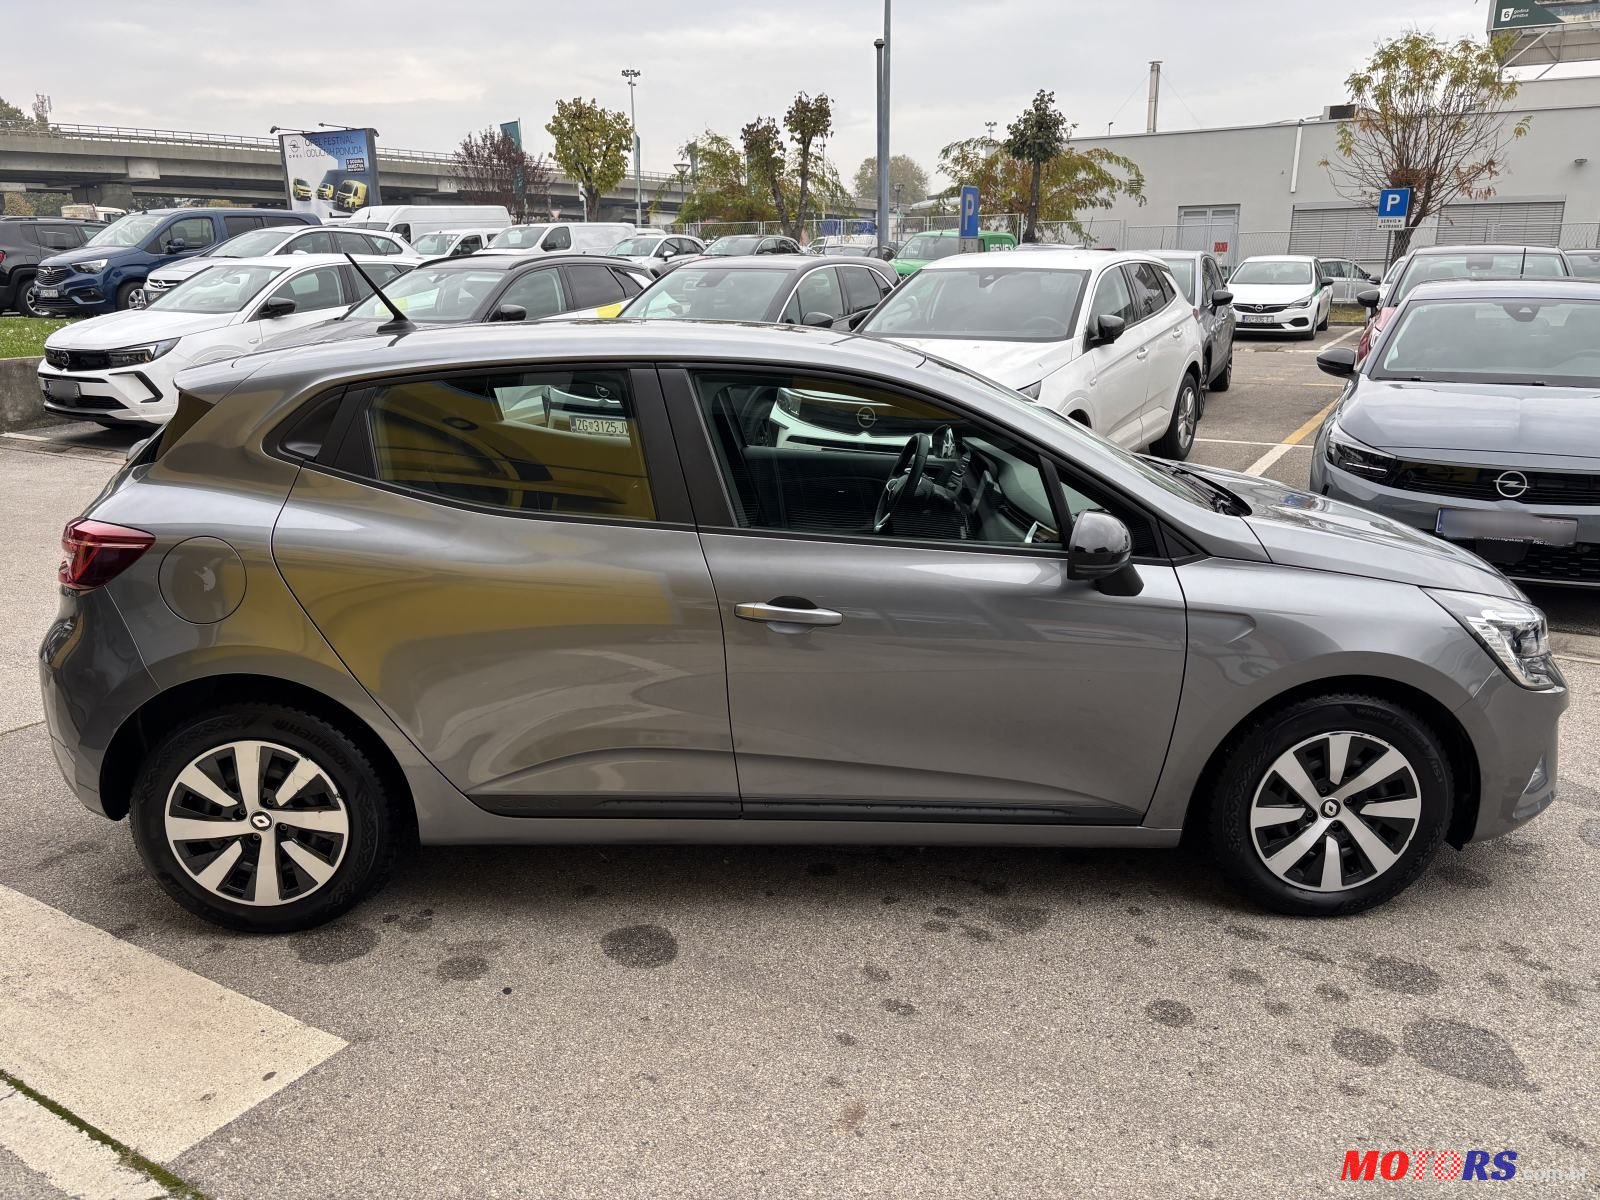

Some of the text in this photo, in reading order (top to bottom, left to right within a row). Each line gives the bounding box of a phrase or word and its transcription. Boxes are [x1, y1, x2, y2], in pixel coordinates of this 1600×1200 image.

[1503, 11, 1510, 19] 6
[964, 193, 975, 231] P
[1386, 194, 1401, 212] P
